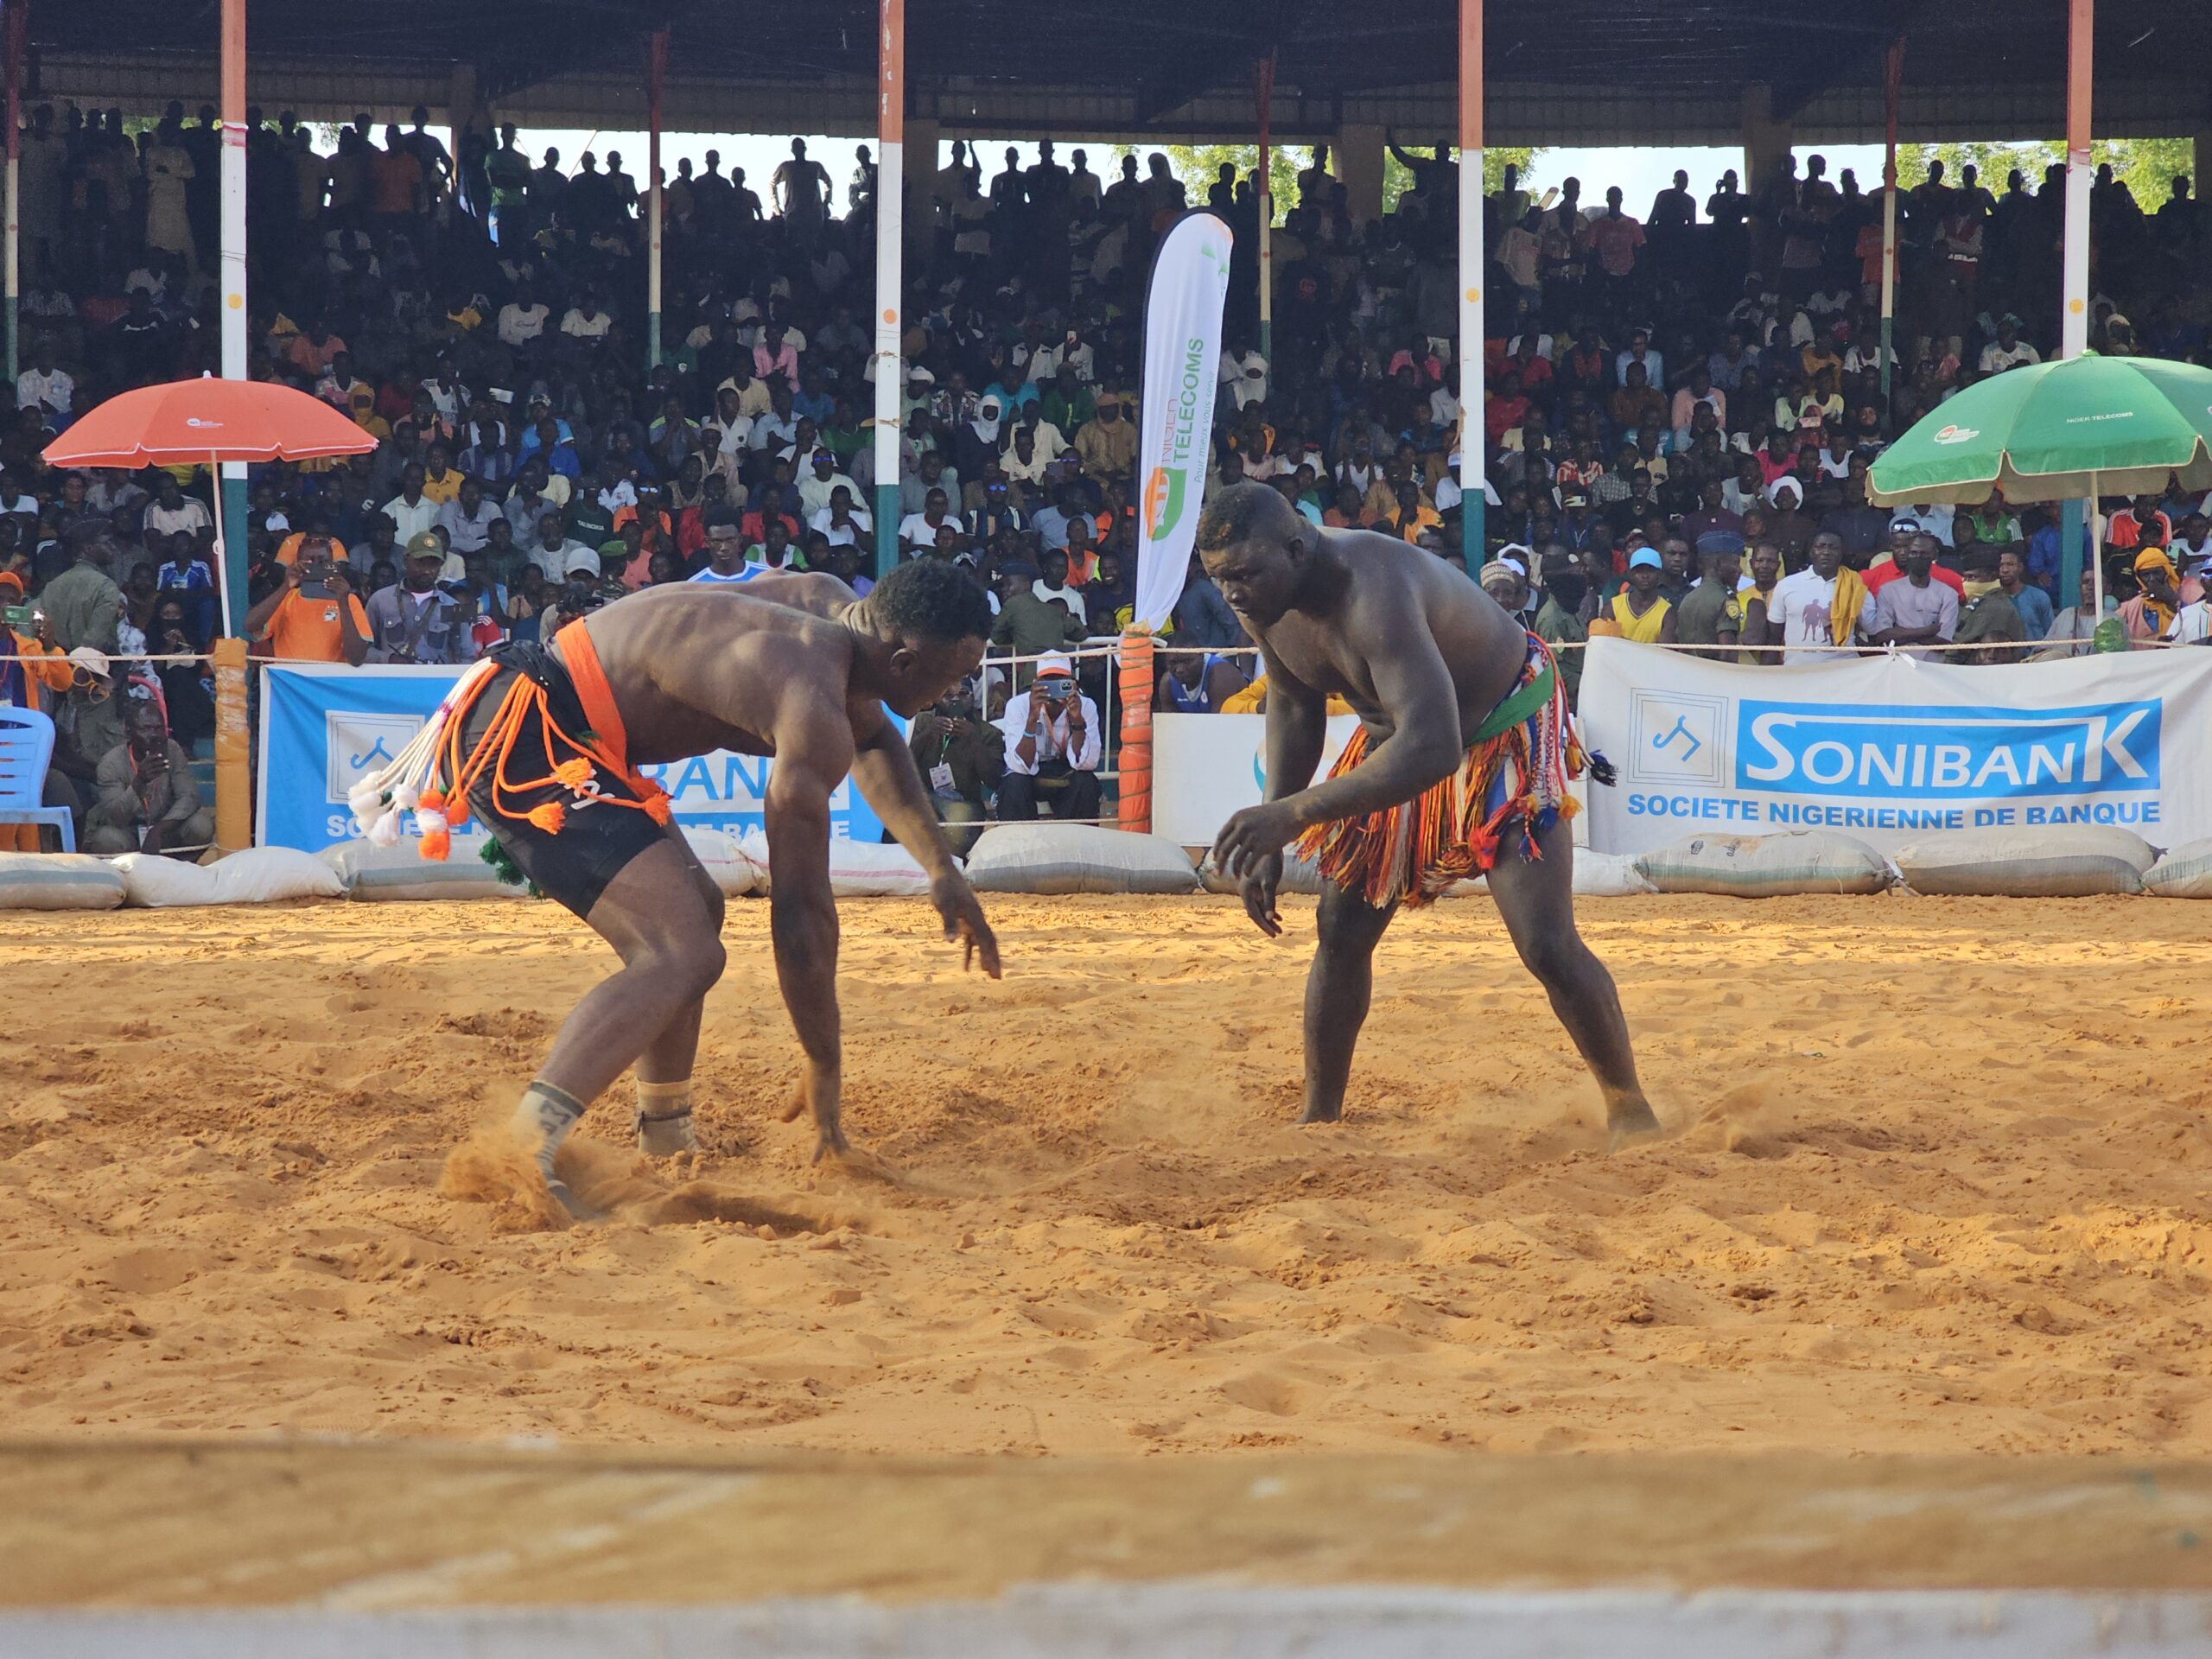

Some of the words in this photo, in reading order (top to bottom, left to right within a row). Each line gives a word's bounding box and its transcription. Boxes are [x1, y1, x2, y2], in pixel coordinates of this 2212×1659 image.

[1173, 338, 1204, 463] TELECOMS
[1199, 427, 1209, 456] mieux
[1195, 461, 1205, 484] Pour
[1627, 793, 1760, 821] SOCIETE
[1769, 802, 1964, 830] NIGERIENNE
[1974, 808, 2016, 828] DE
[2026, 801, 2160, 826] BANQUE
